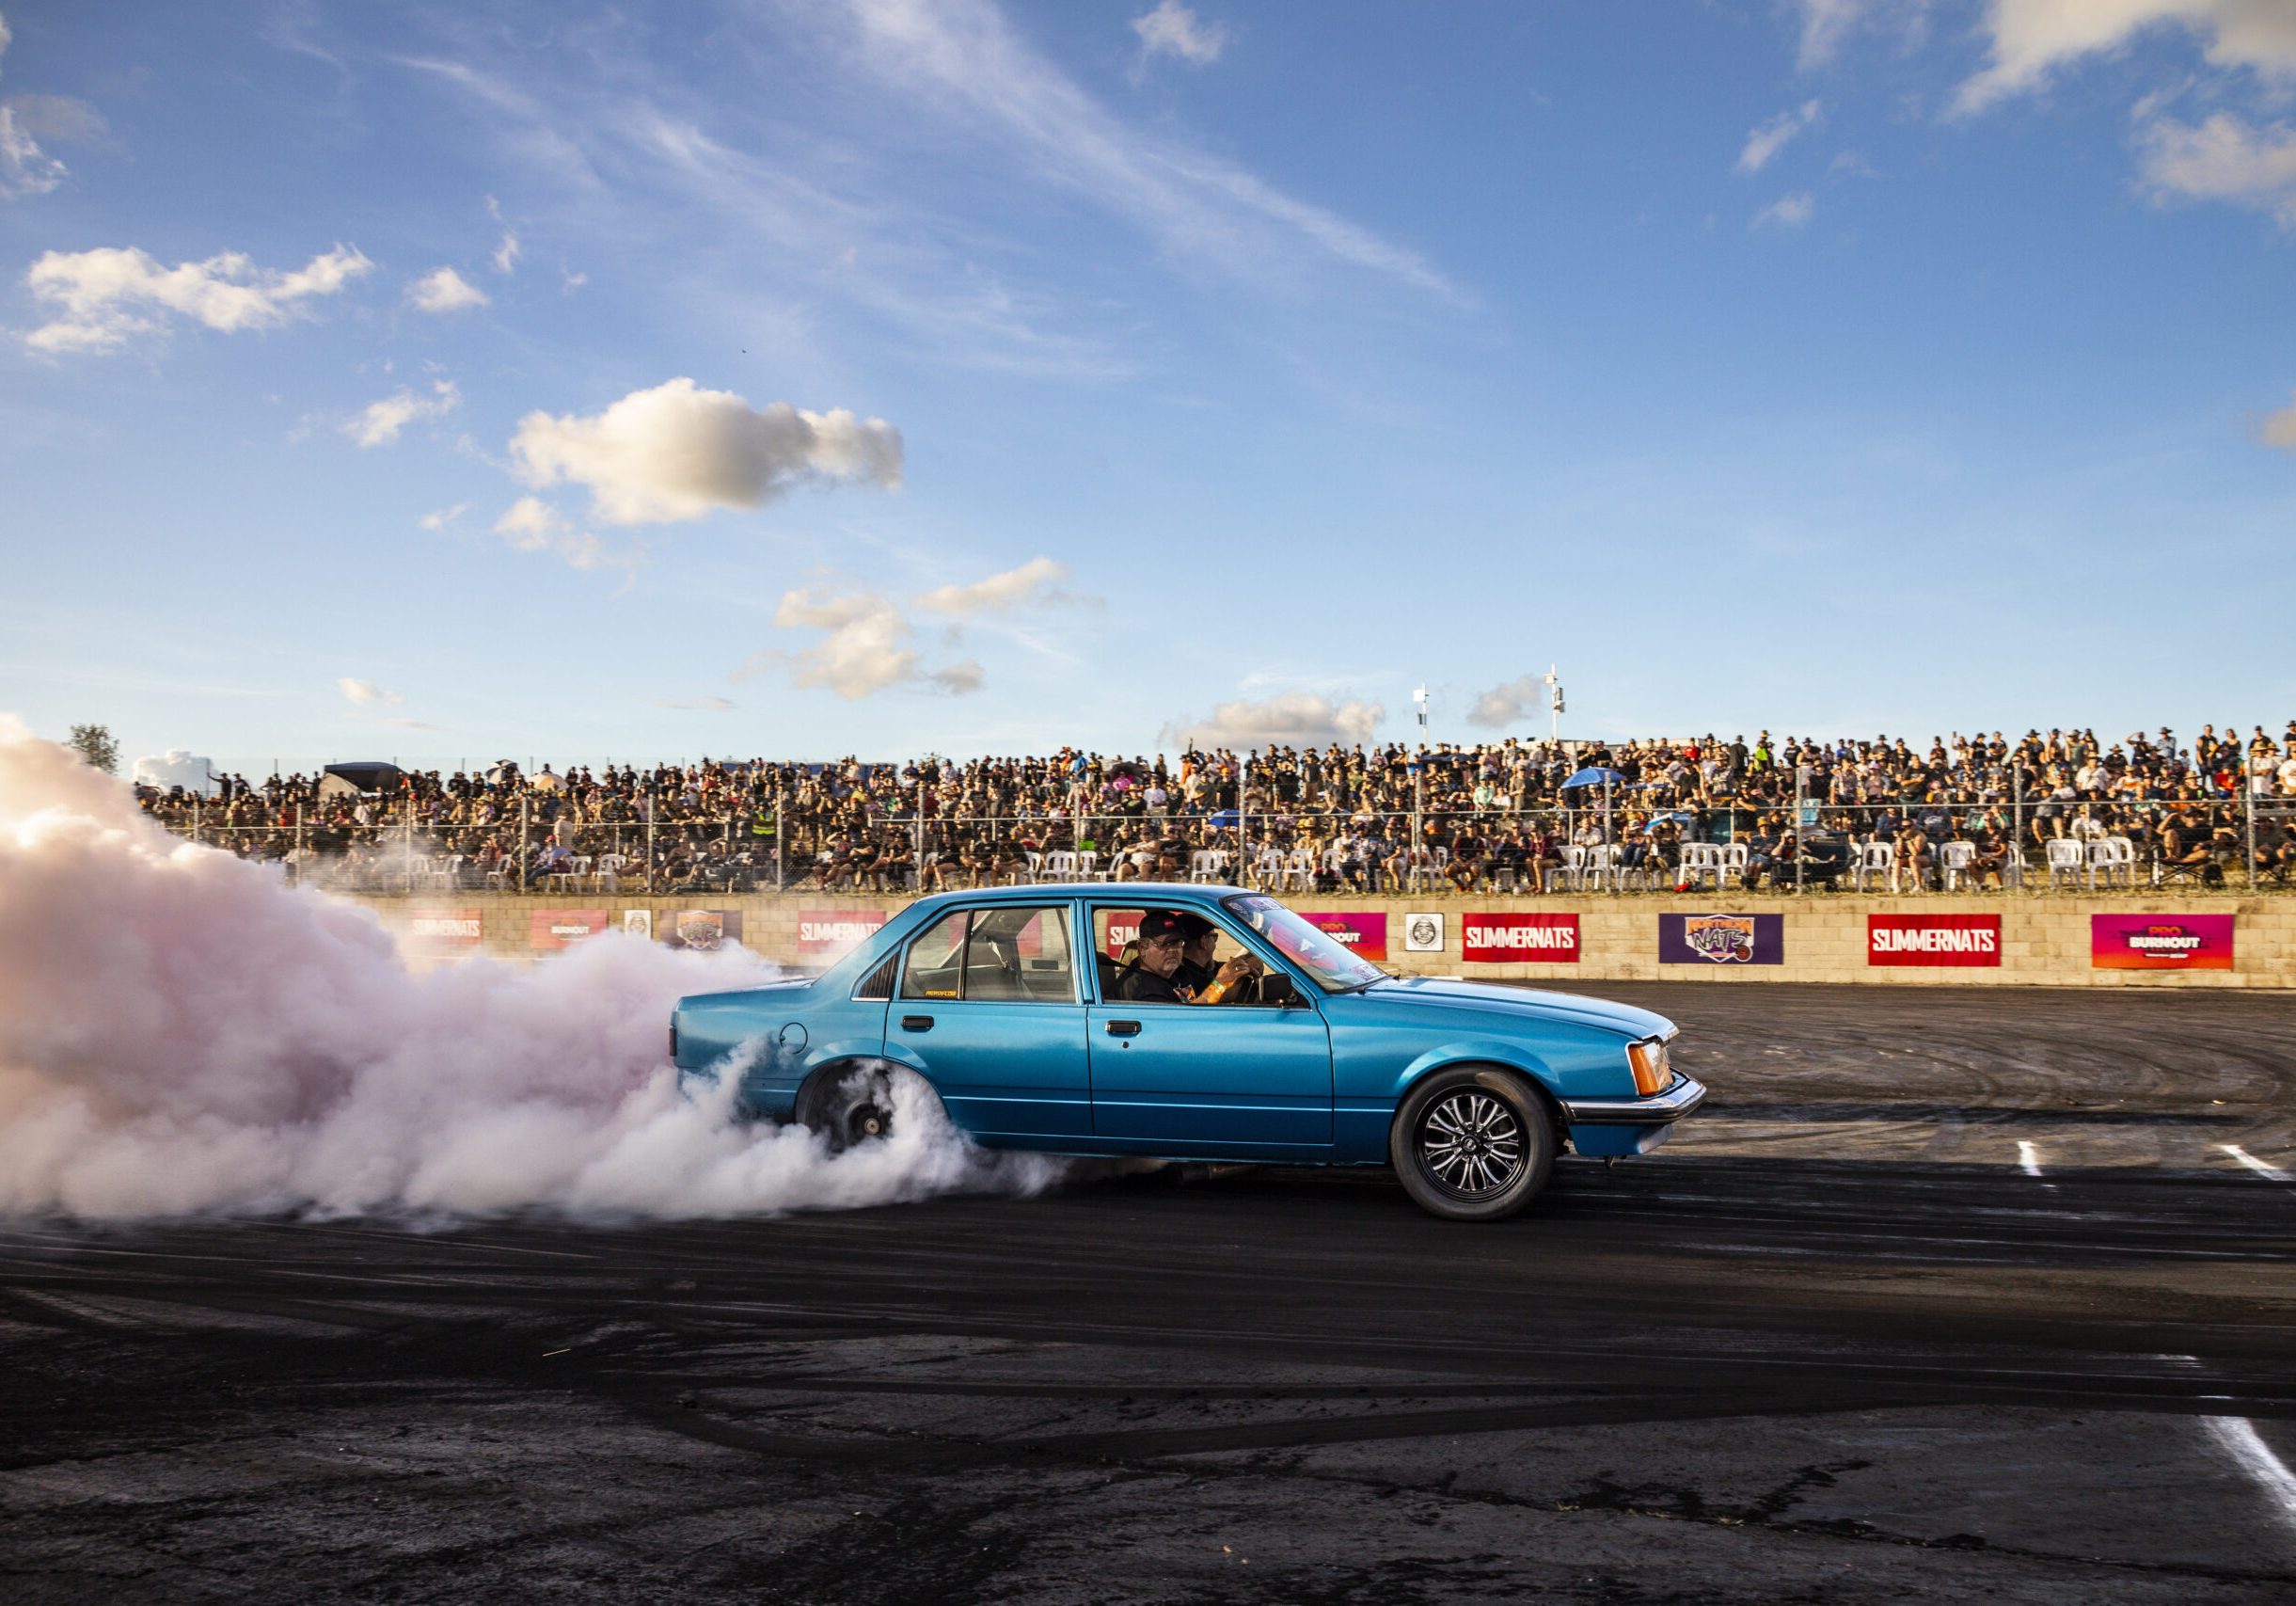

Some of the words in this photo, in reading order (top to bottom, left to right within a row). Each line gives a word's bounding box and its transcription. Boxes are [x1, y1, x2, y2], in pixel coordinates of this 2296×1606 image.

[1466, 927, 1574, 948] SUMMERNATS
[1693, 928, 1747, 951] NATS
[1873, 929, 1994, 951] SUMMERNATS
[2148, 926, 2181, 936] PRO
[2130, 937, 2200, 948] BURNOUT
